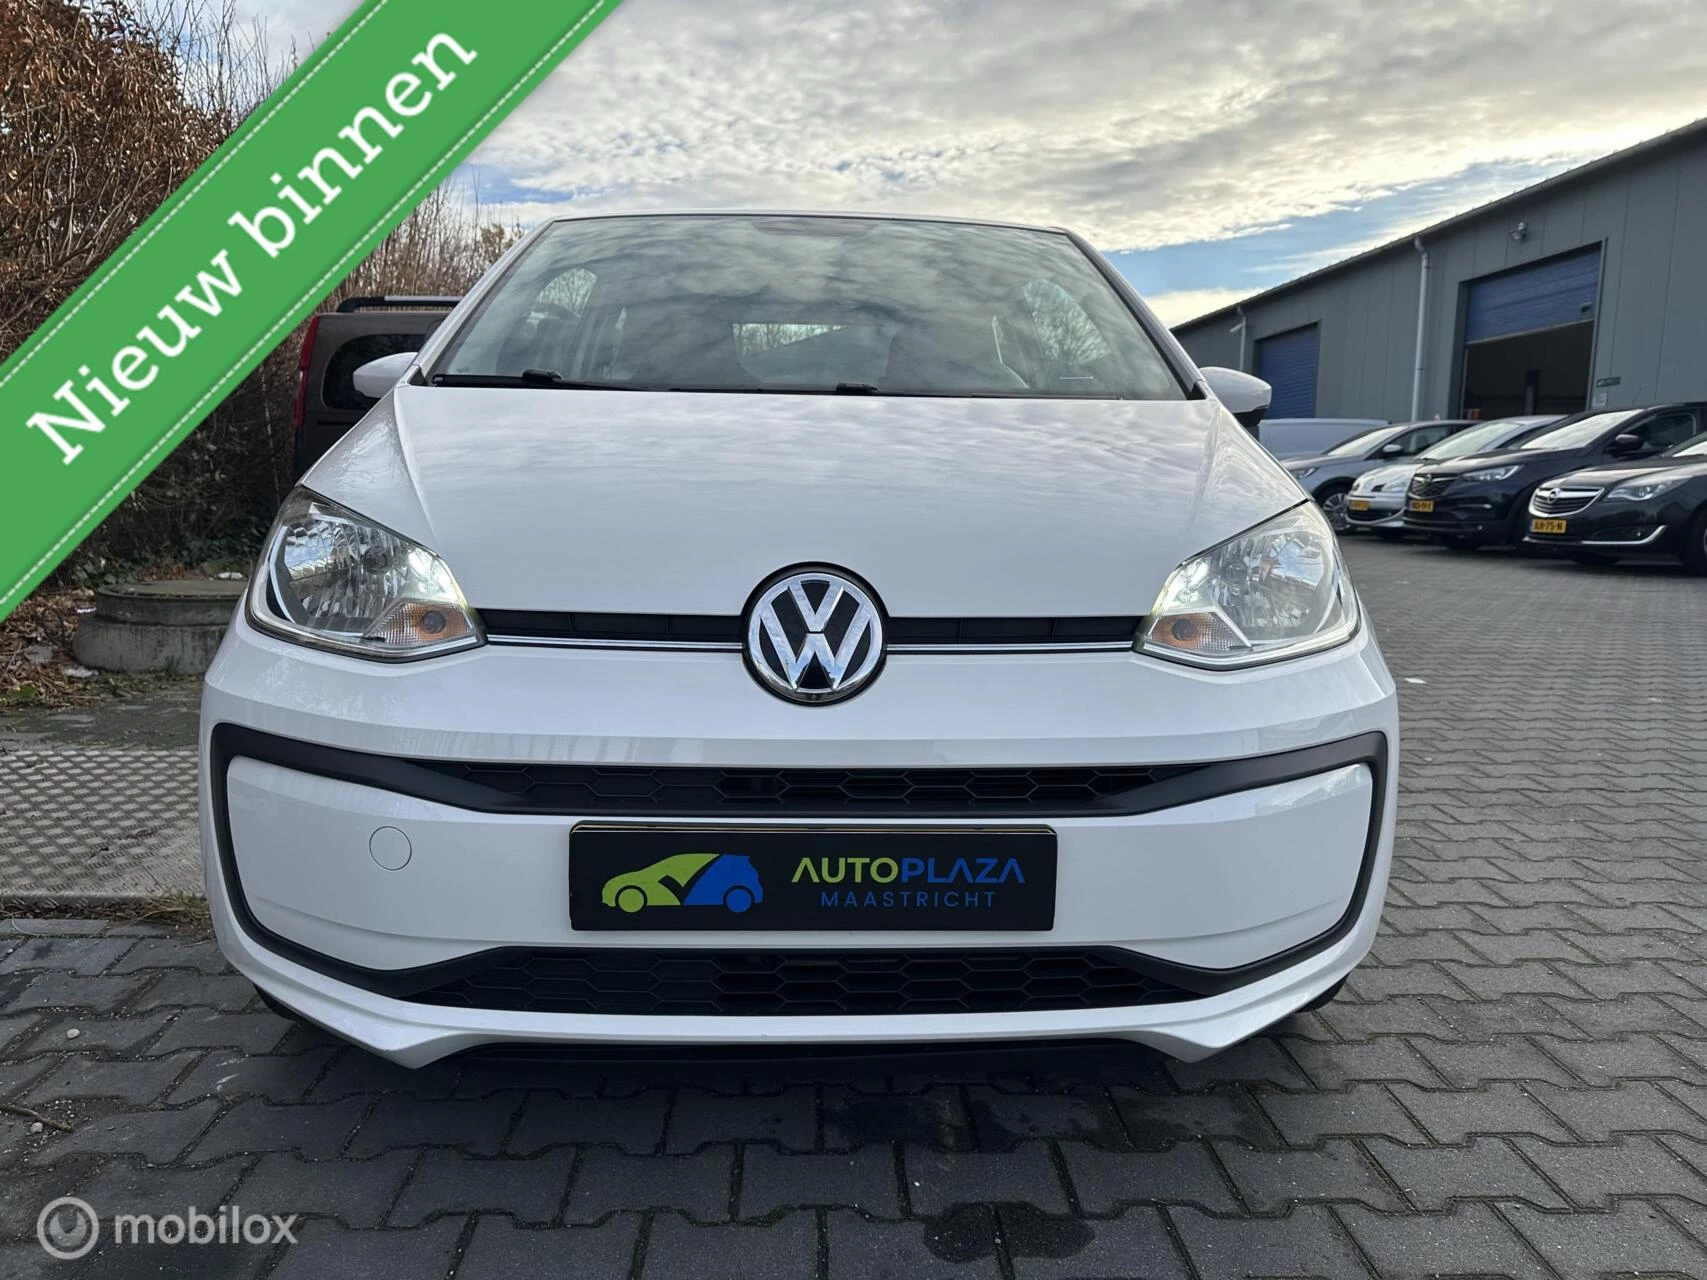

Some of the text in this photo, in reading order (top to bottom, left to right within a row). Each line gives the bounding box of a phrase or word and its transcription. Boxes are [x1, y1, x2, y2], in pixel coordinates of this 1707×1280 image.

[750, 574, 882, 695] VW
[791, 856, 1026, 884] AUTOPLAZA
[820, 890, 996, 908] MAASTRICHT
